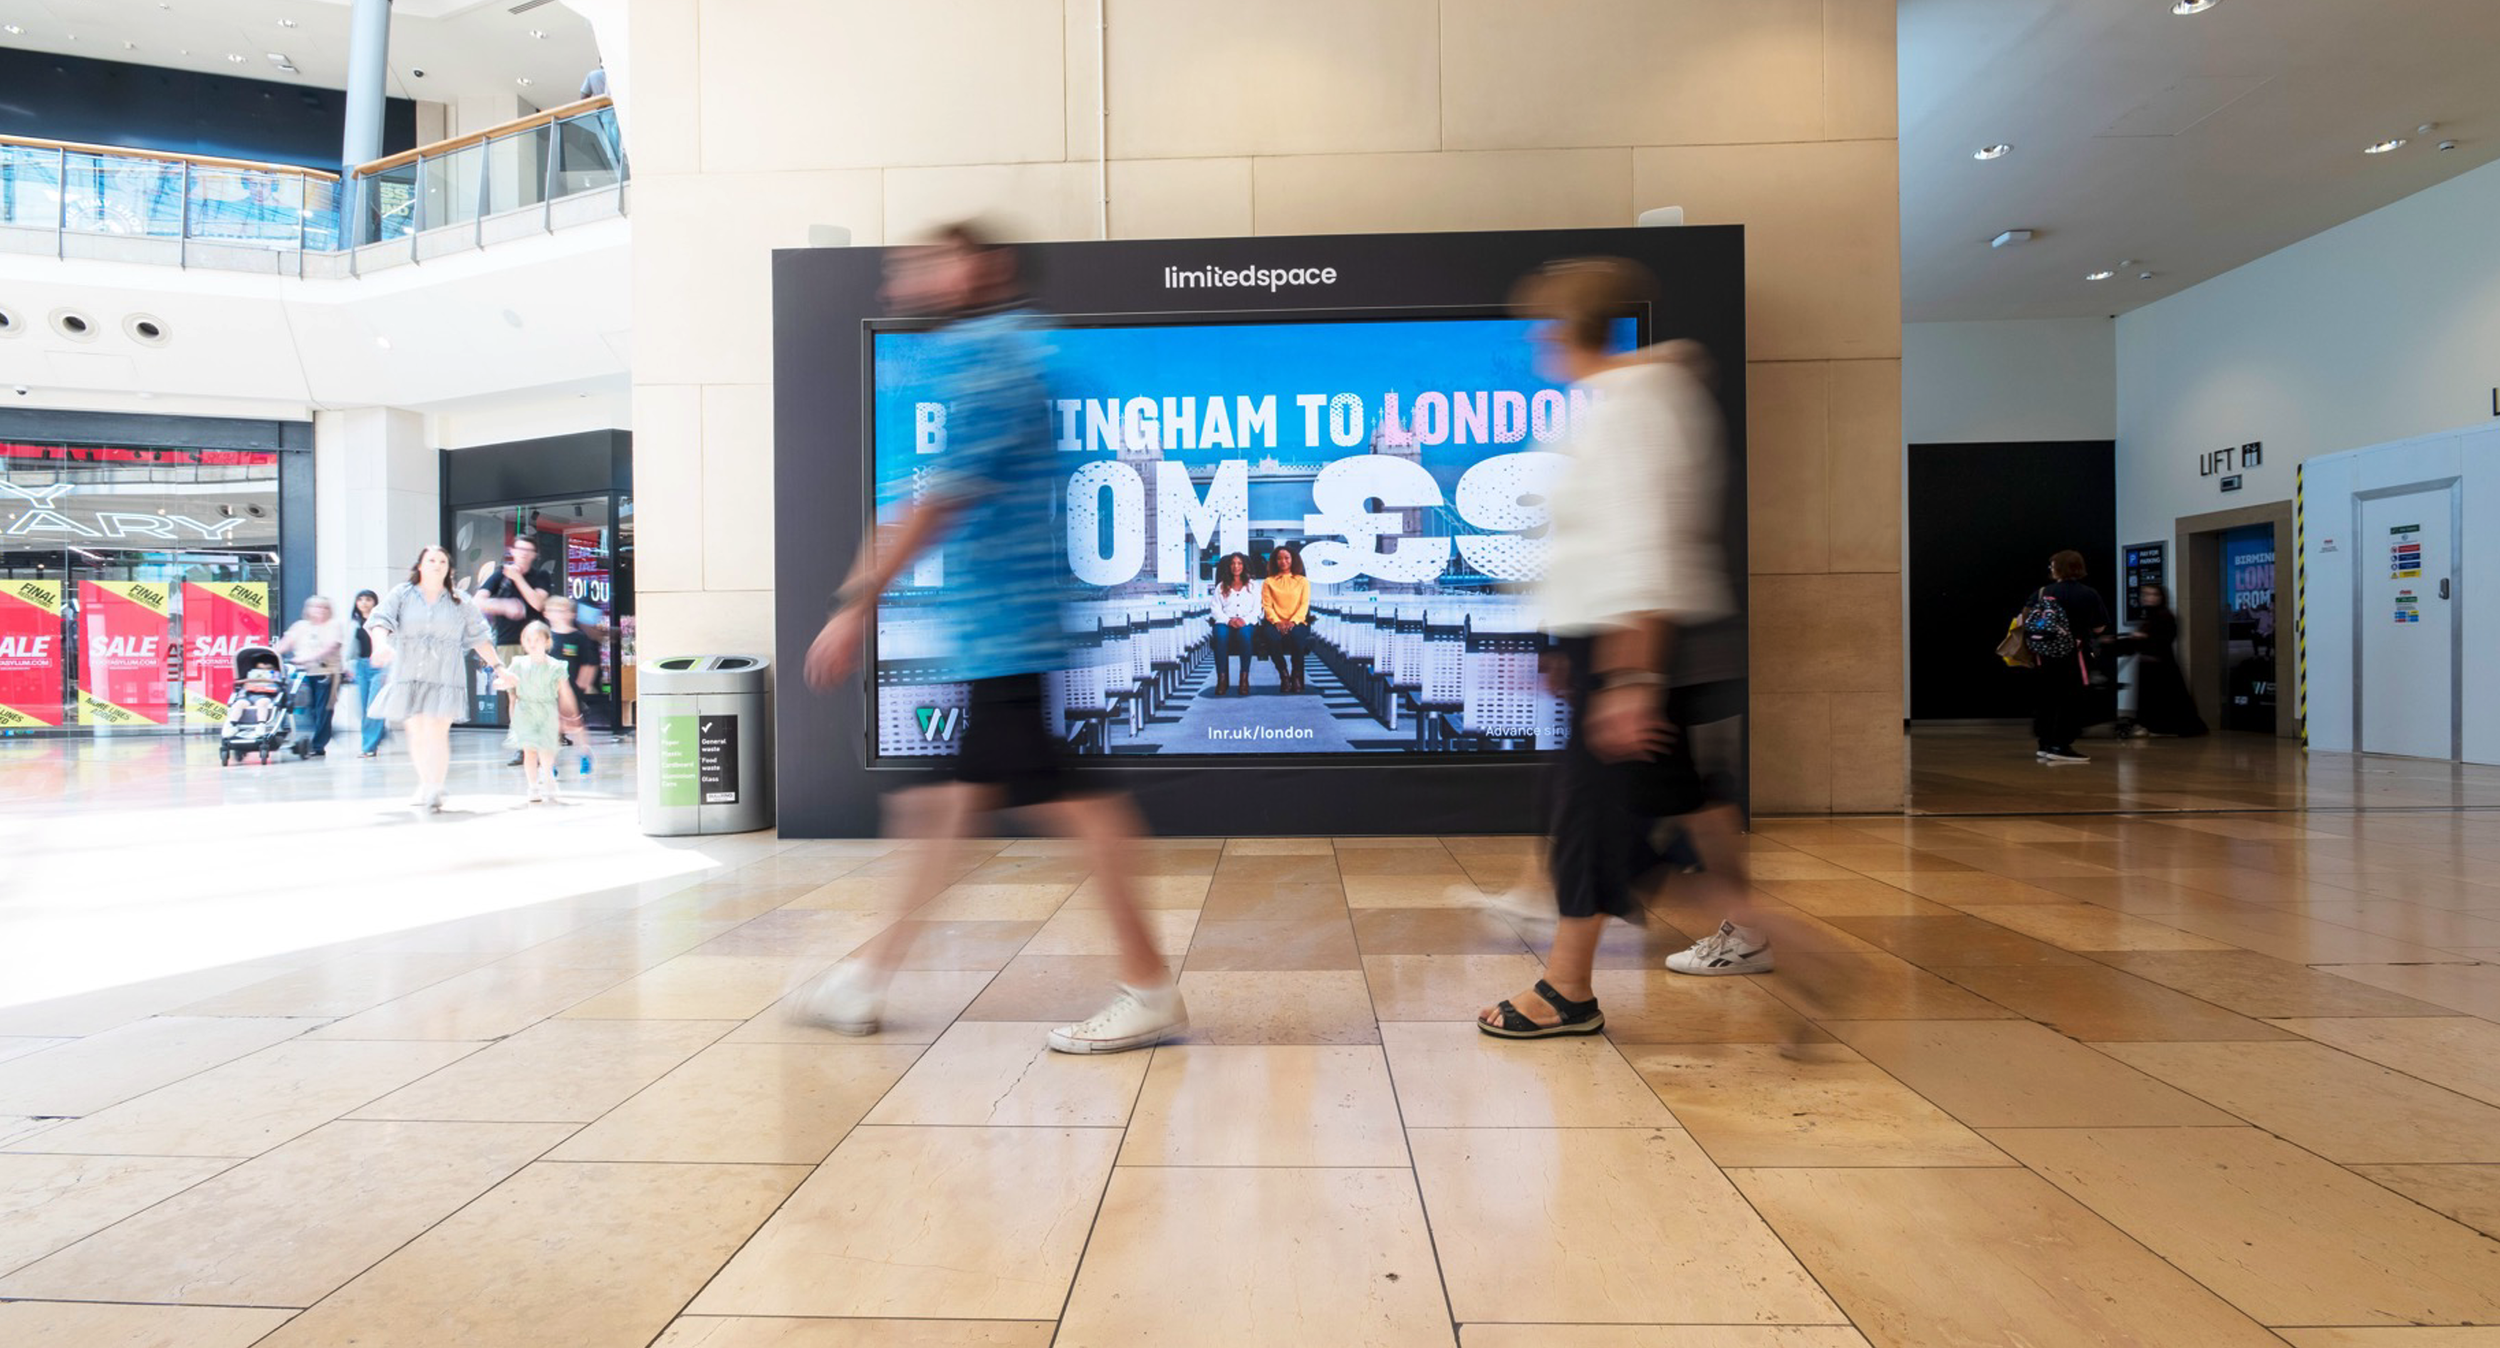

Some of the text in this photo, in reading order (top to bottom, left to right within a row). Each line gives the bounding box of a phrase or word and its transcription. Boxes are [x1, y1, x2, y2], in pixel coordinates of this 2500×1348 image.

[1165, 265, 1337, 292] limitedspace
[915, 394, 1277, 454] BINGHAM
[1297, 392, 1364, 447] TO
[2200, 447, 2236, 476] LIFT
[0, 510, 246, 539] ARY
[20, 582, 56, 604] FINAL
[130, 584, 164, 605] FINAL
[230, 585, 263, 606] FINAL
[0, 636, 51, 658] ALE
[91, 636, 159, 658] SALE
[110, 706, 132, 721] LINES
[1208, 725, 1313, 740] lnr.uk/london
[1544, 726, 1573, 739] sing
